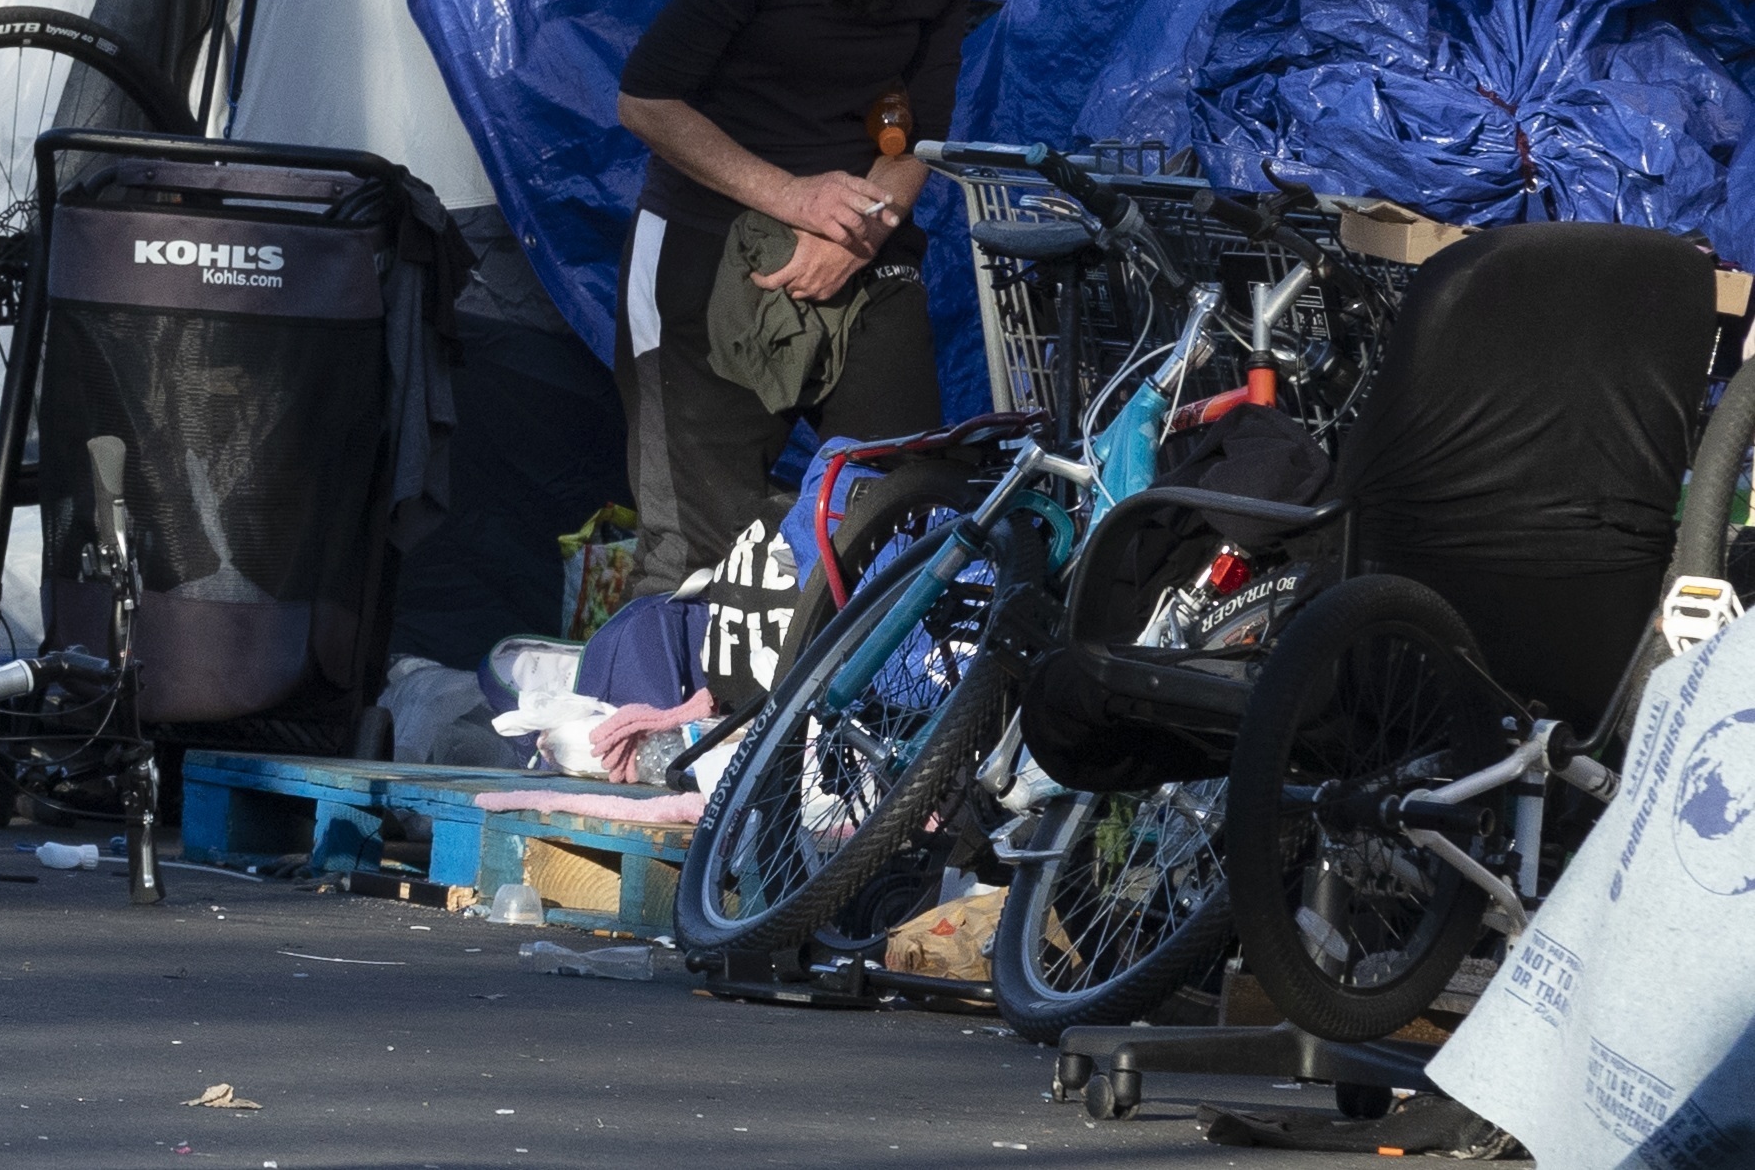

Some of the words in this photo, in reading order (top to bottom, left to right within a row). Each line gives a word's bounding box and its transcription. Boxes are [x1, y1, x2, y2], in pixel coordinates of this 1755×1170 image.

[46, 23, 81, 40] byway
[81, 33, 94, 44] 40
[134, 239, 285, 271] KOHL'S
[202, 268, 284, 289] Kohls.com
[702, 698, 778, 830] BONTRAGER
[1511, 964, 1533, 989] OR
[1521, 946, 1554, 977] NOT
[1558, 968, 1573, 991] TO
